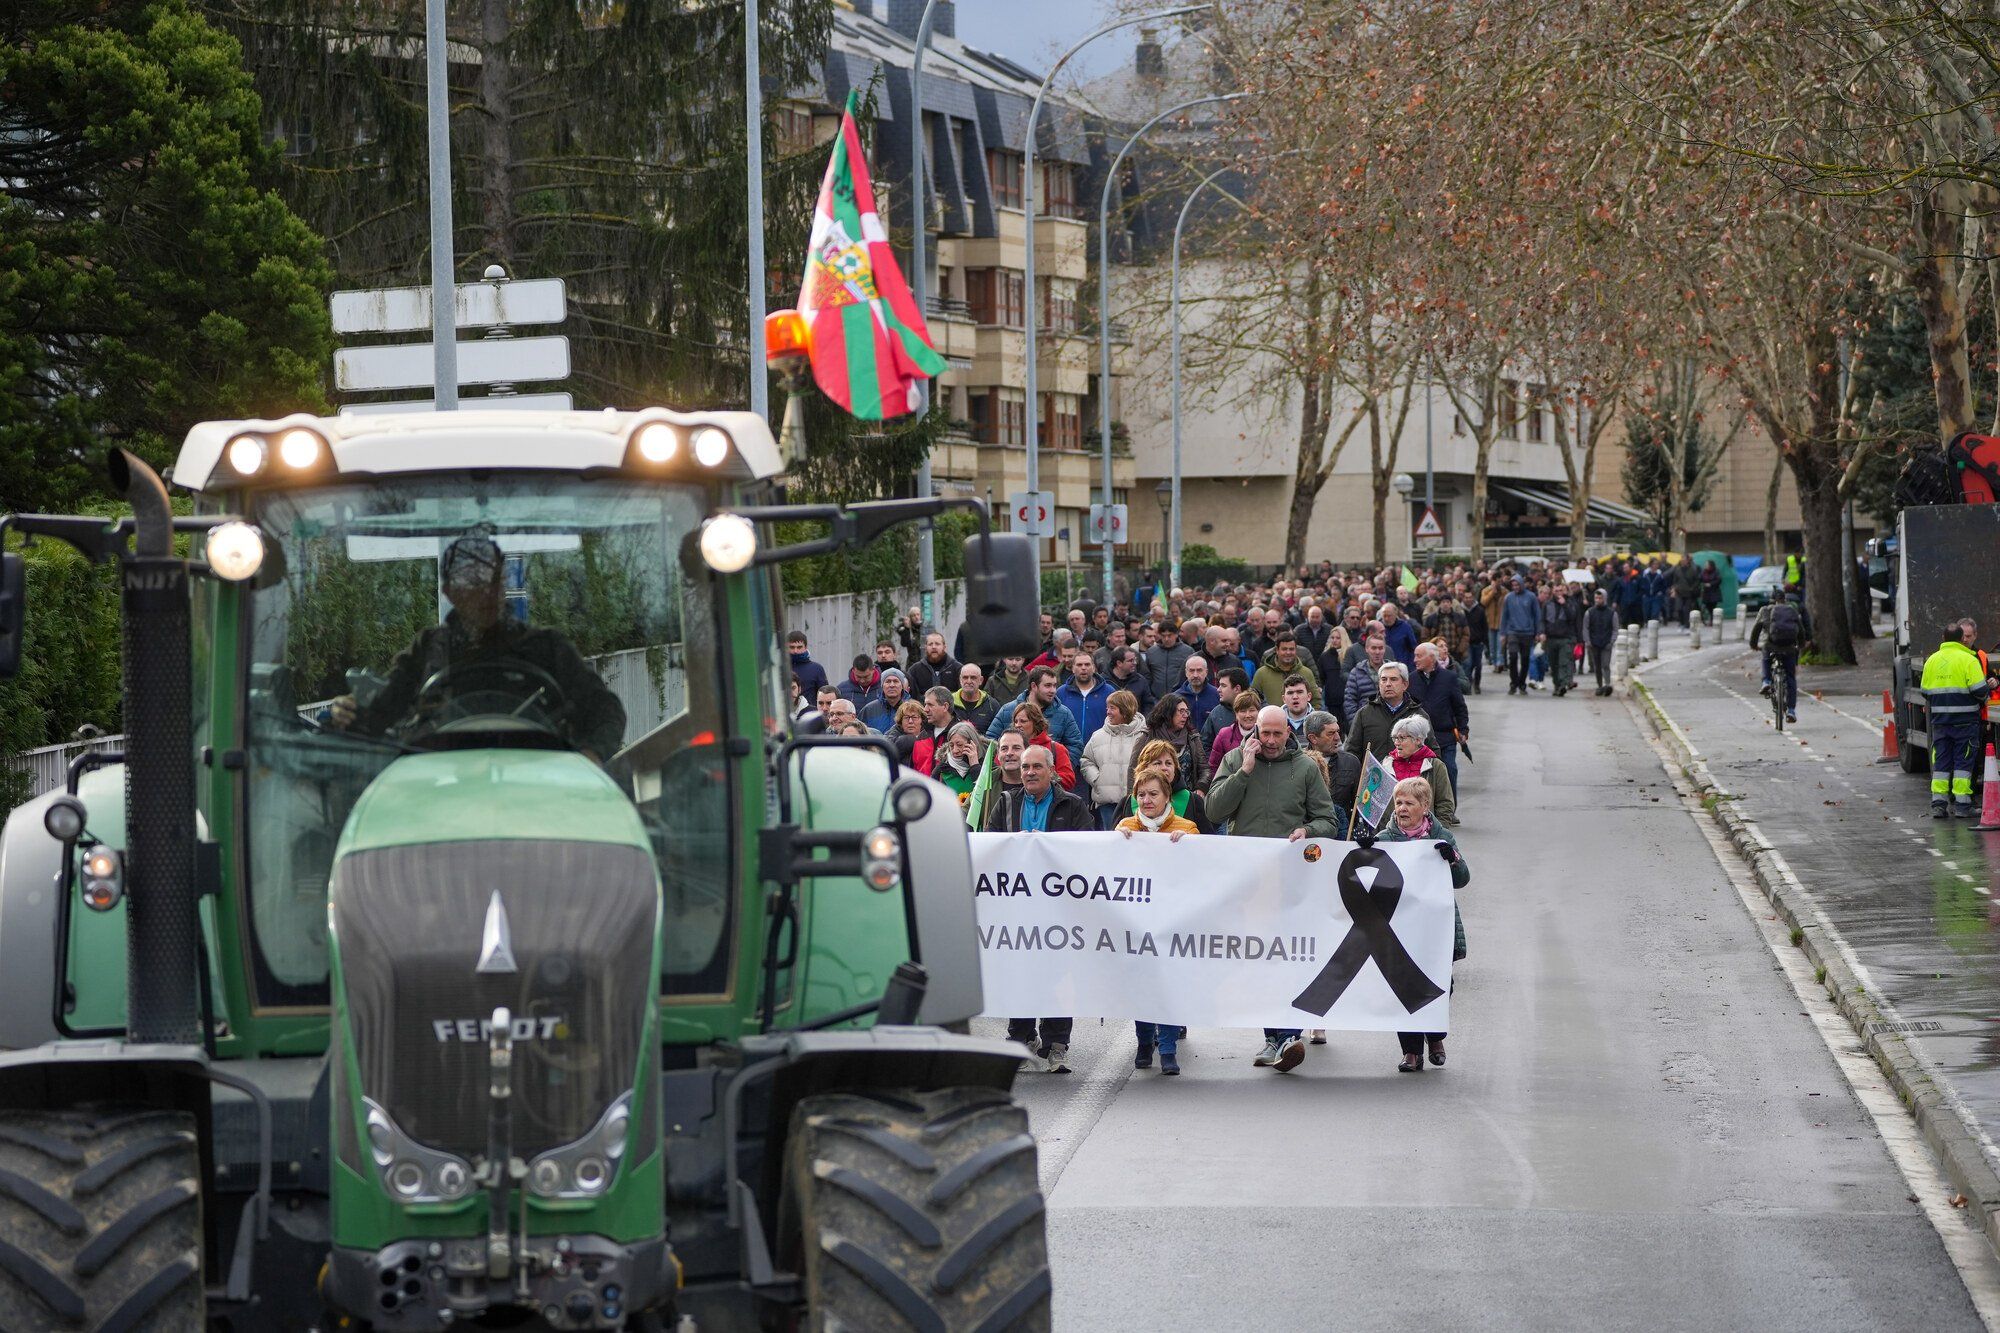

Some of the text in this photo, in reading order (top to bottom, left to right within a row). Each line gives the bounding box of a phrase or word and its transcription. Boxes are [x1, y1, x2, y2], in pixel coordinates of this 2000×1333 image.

[975, 872, 1152, 903] ARA GOAZ!!!
[977, 925, 1317, 962] VAMOS A LA MIERDA!!!
